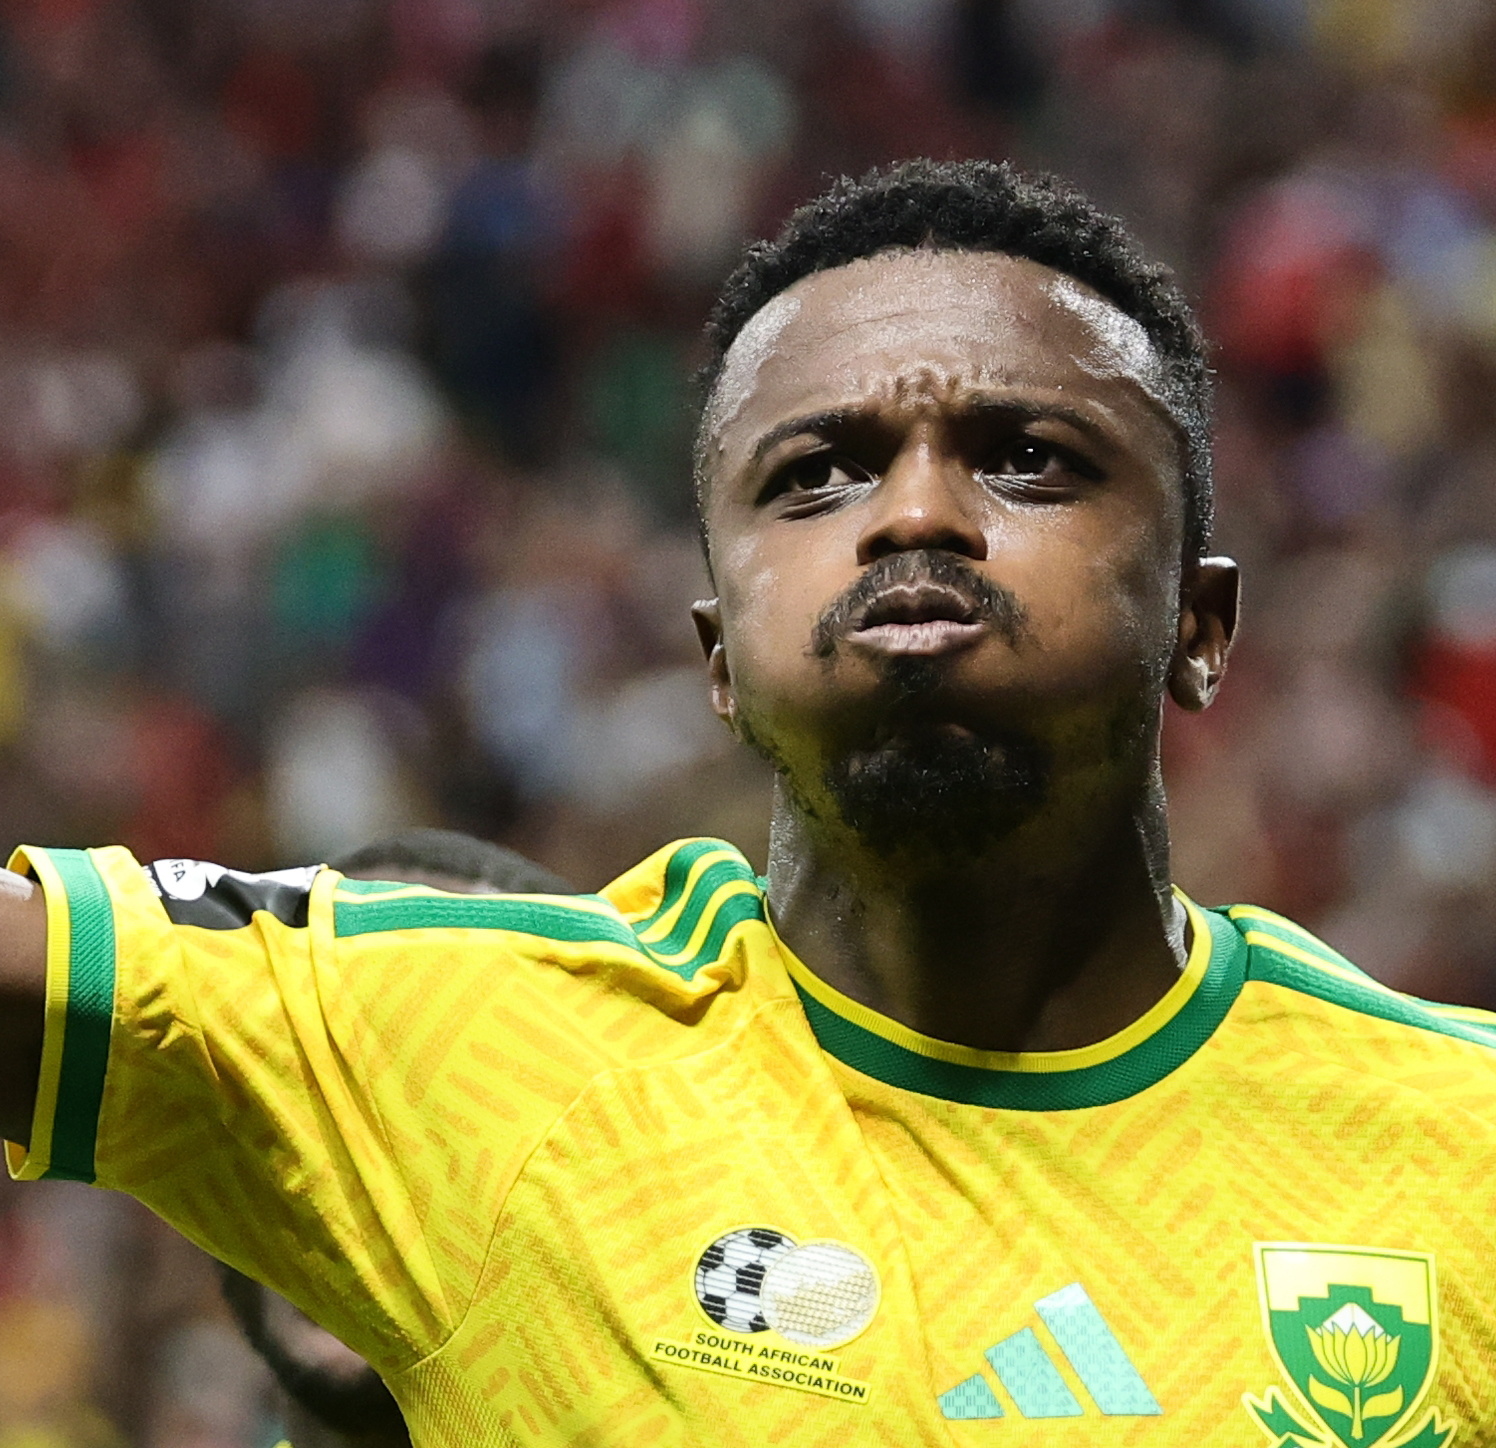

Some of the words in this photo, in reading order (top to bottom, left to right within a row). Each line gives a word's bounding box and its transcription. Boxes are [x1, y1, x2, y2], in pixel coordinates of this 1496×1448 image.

[654, 1342, 741, 1372] FOOTBALL
[747, 1363, 866, 1398] ASSOCIATION
[695, 1333, 753, 1356] SOUTH
[758, 1347, 834, 1372] AFRICAN
